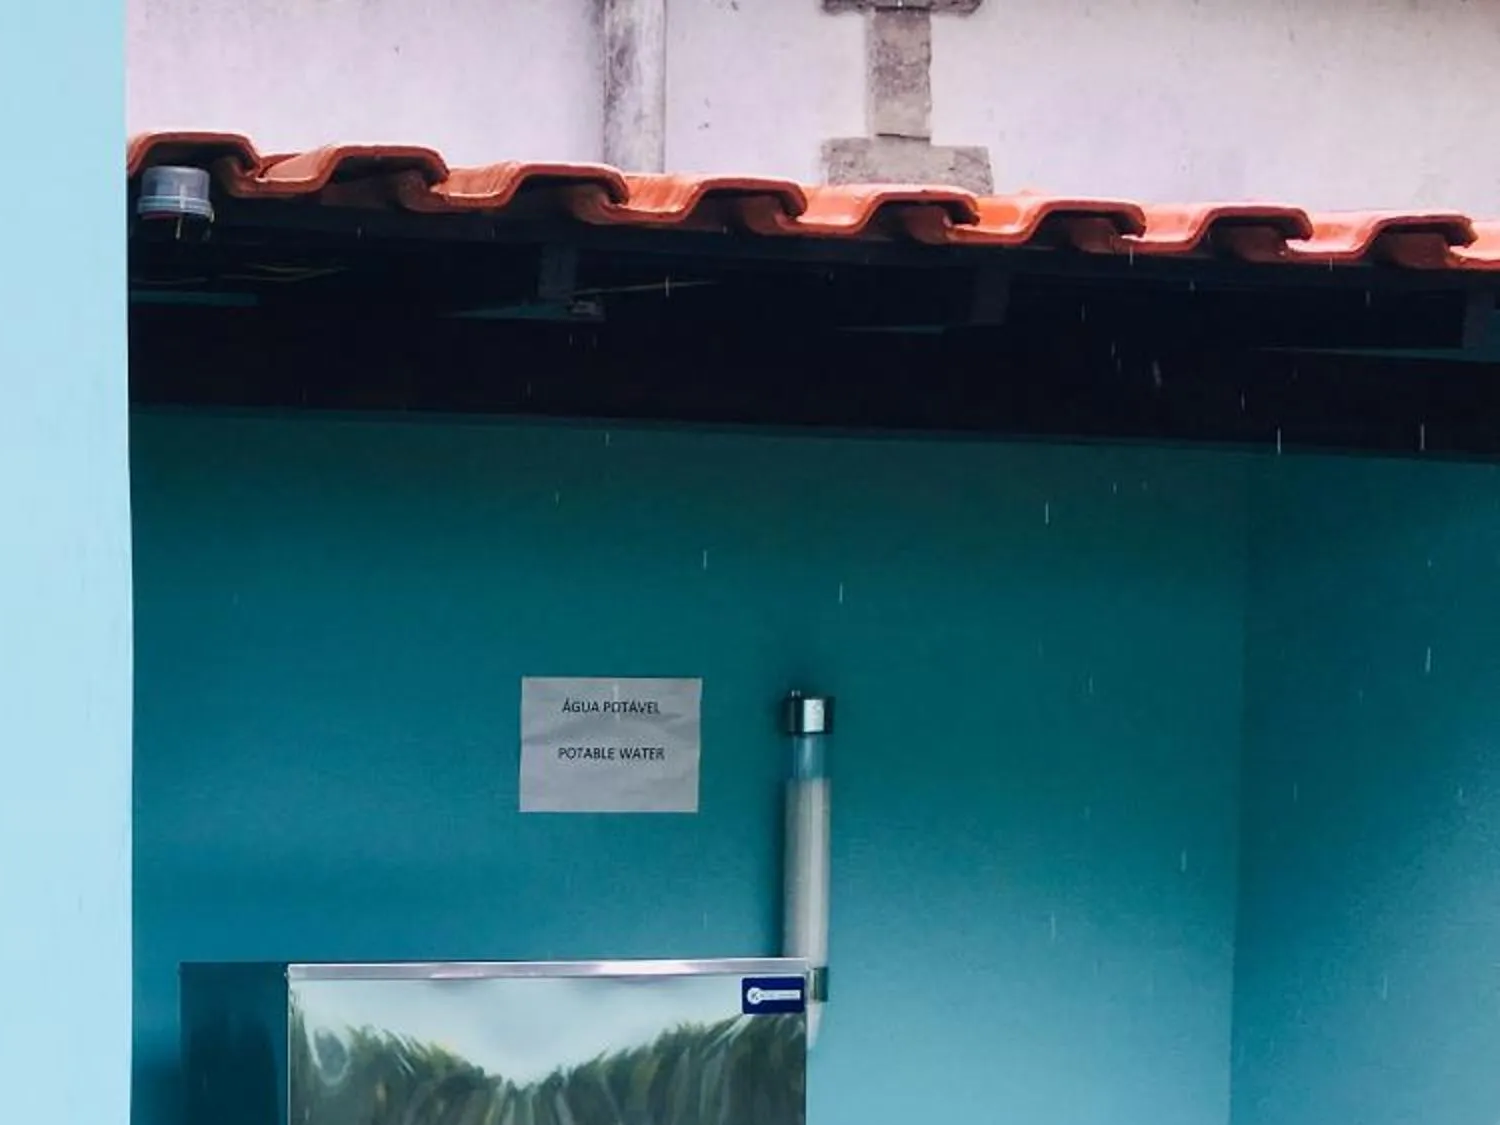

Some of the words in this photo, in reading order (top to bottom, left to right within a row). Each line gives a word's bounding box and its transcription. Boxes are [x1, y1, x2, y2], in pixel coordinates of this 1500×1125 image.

[562, 697, 599, 713] ÁGUA
[603, 699, 660, 714] POTÁVEL
[558, 747, 615, 760] POTABLE
[619, 747, 665, 760] WATER
